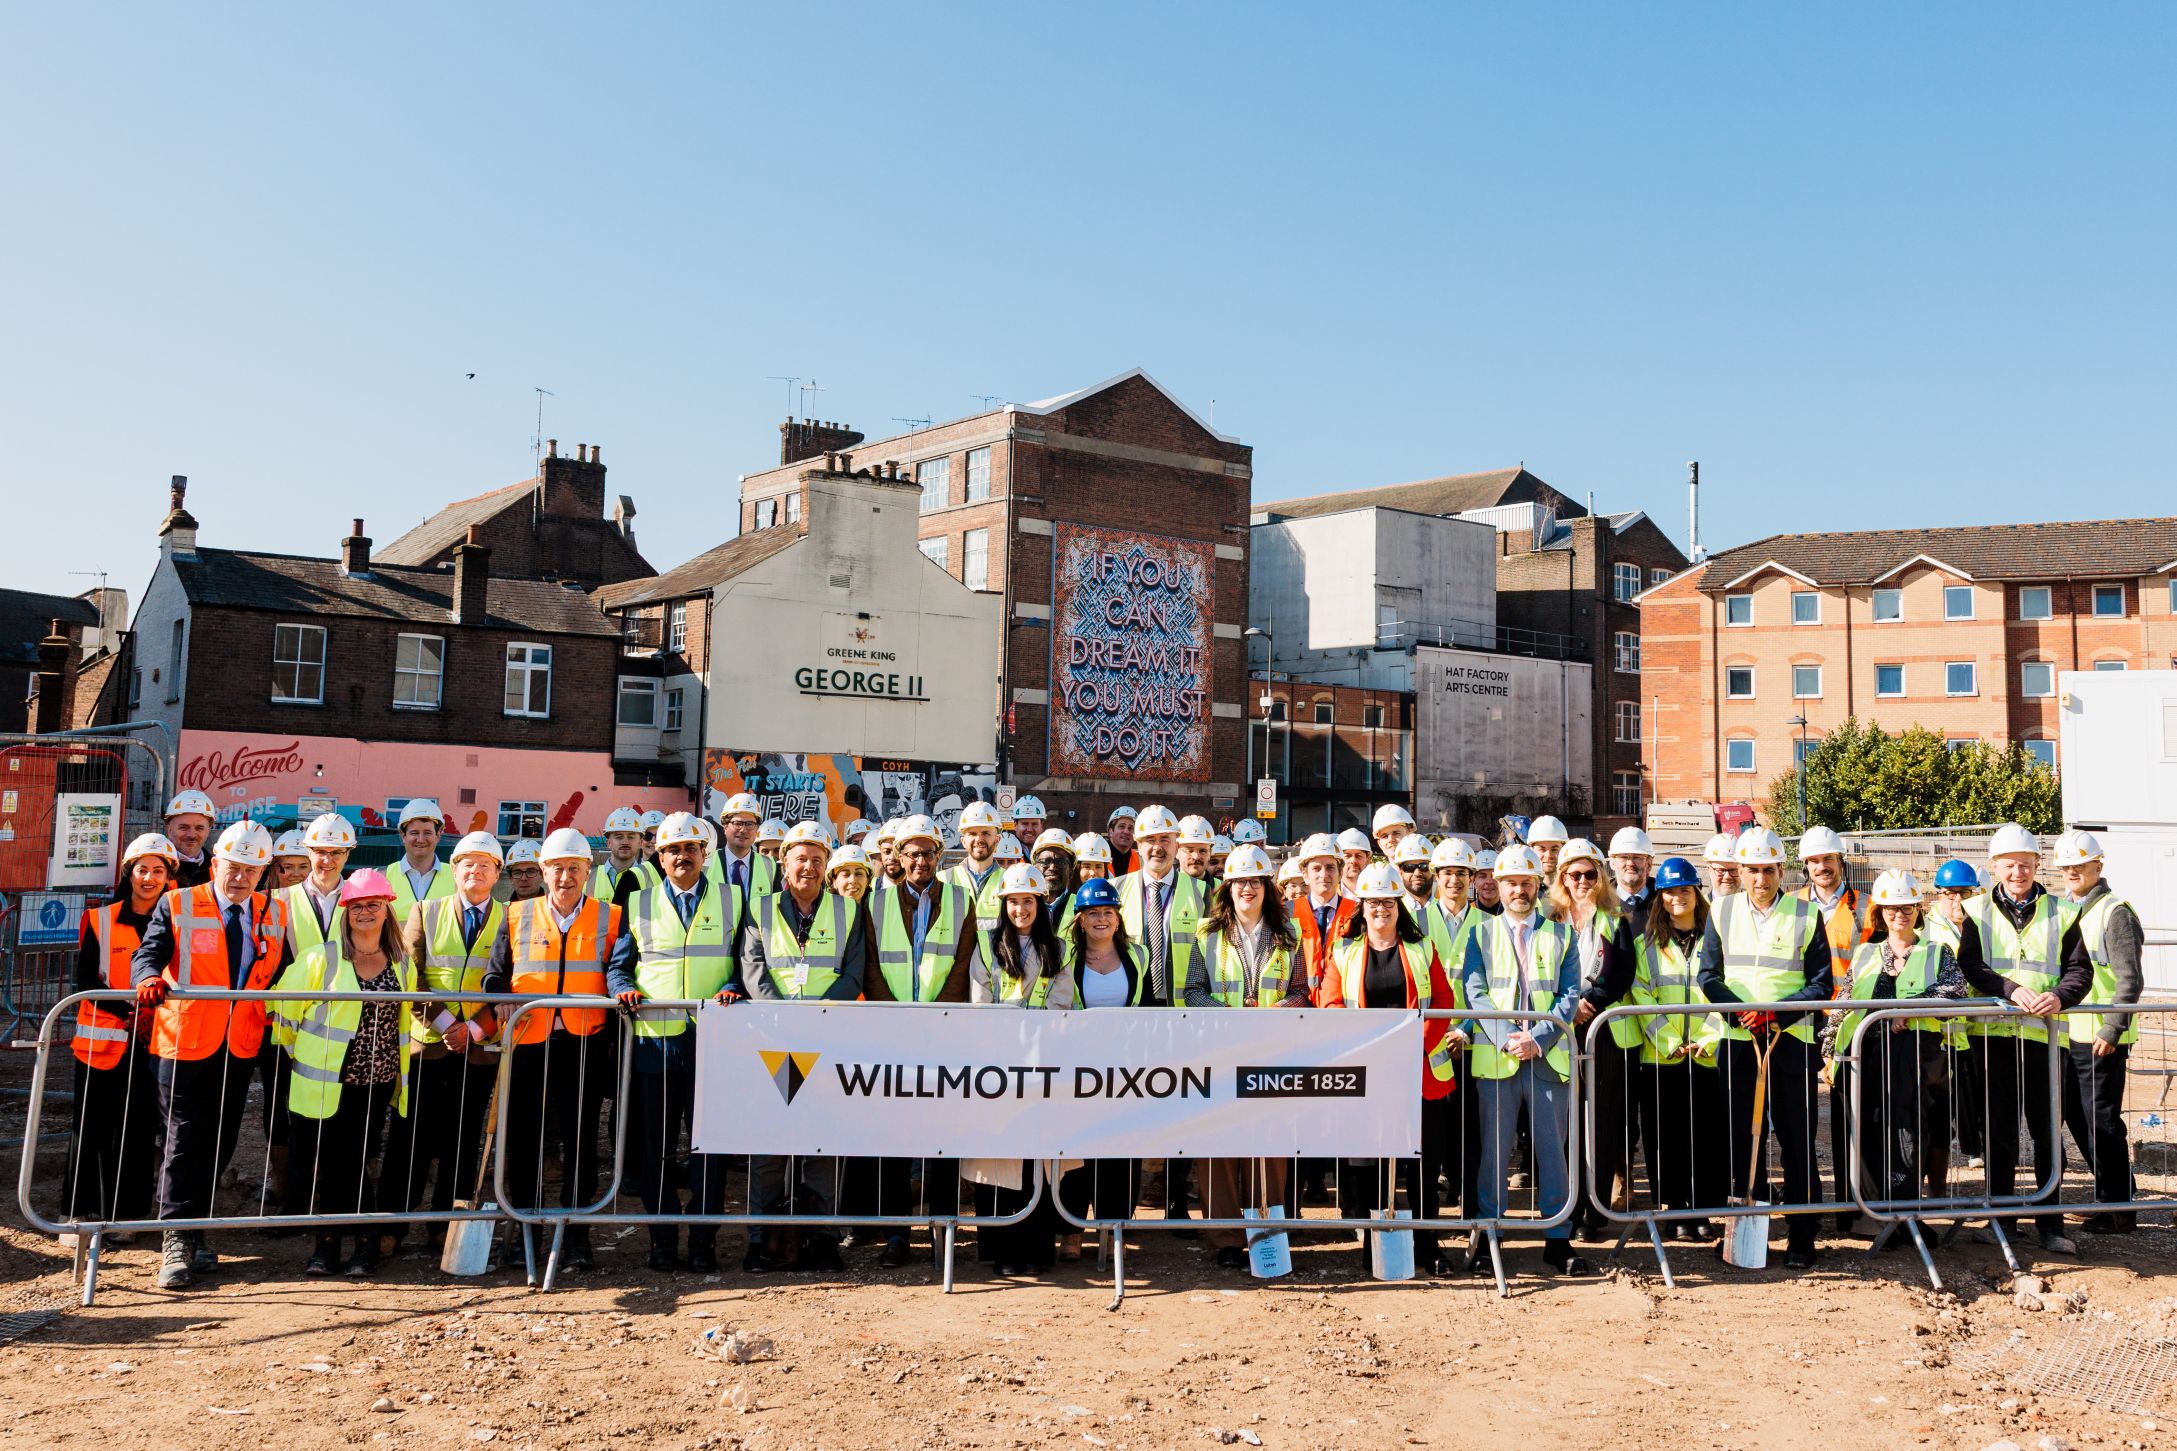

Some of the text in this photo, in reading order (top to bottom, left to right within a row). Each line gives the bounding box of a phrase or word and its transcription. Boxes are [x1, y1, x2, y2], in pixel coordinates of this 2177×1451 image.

[1092, 552, 1182, 589] IF YOU
[1105, 596, 1168, 631] CAN
[827, 647, 896, 662] GREENE KING
[1070, 635, 1201, 675] DREAM IT
[795, 667, 923, 697] GEORGE II
[1445, 666, 1509, 682] HAT FACTORY
[1445, 682, 1508, 697] ARTS CENTRE
[1059, 679, 1206, 718] YOU MUST
[1096, 726, 1171, 759] DO IT
[180, 741, 304, 791] Welcome
[882, 761, 910, 771] COYH
[230, 786, 247, 797] TO
[744, 772, 827, 794] IT STARTS
[836, 1064, 1356, 1098] WILLMOTT DIXON SINCE 1852
